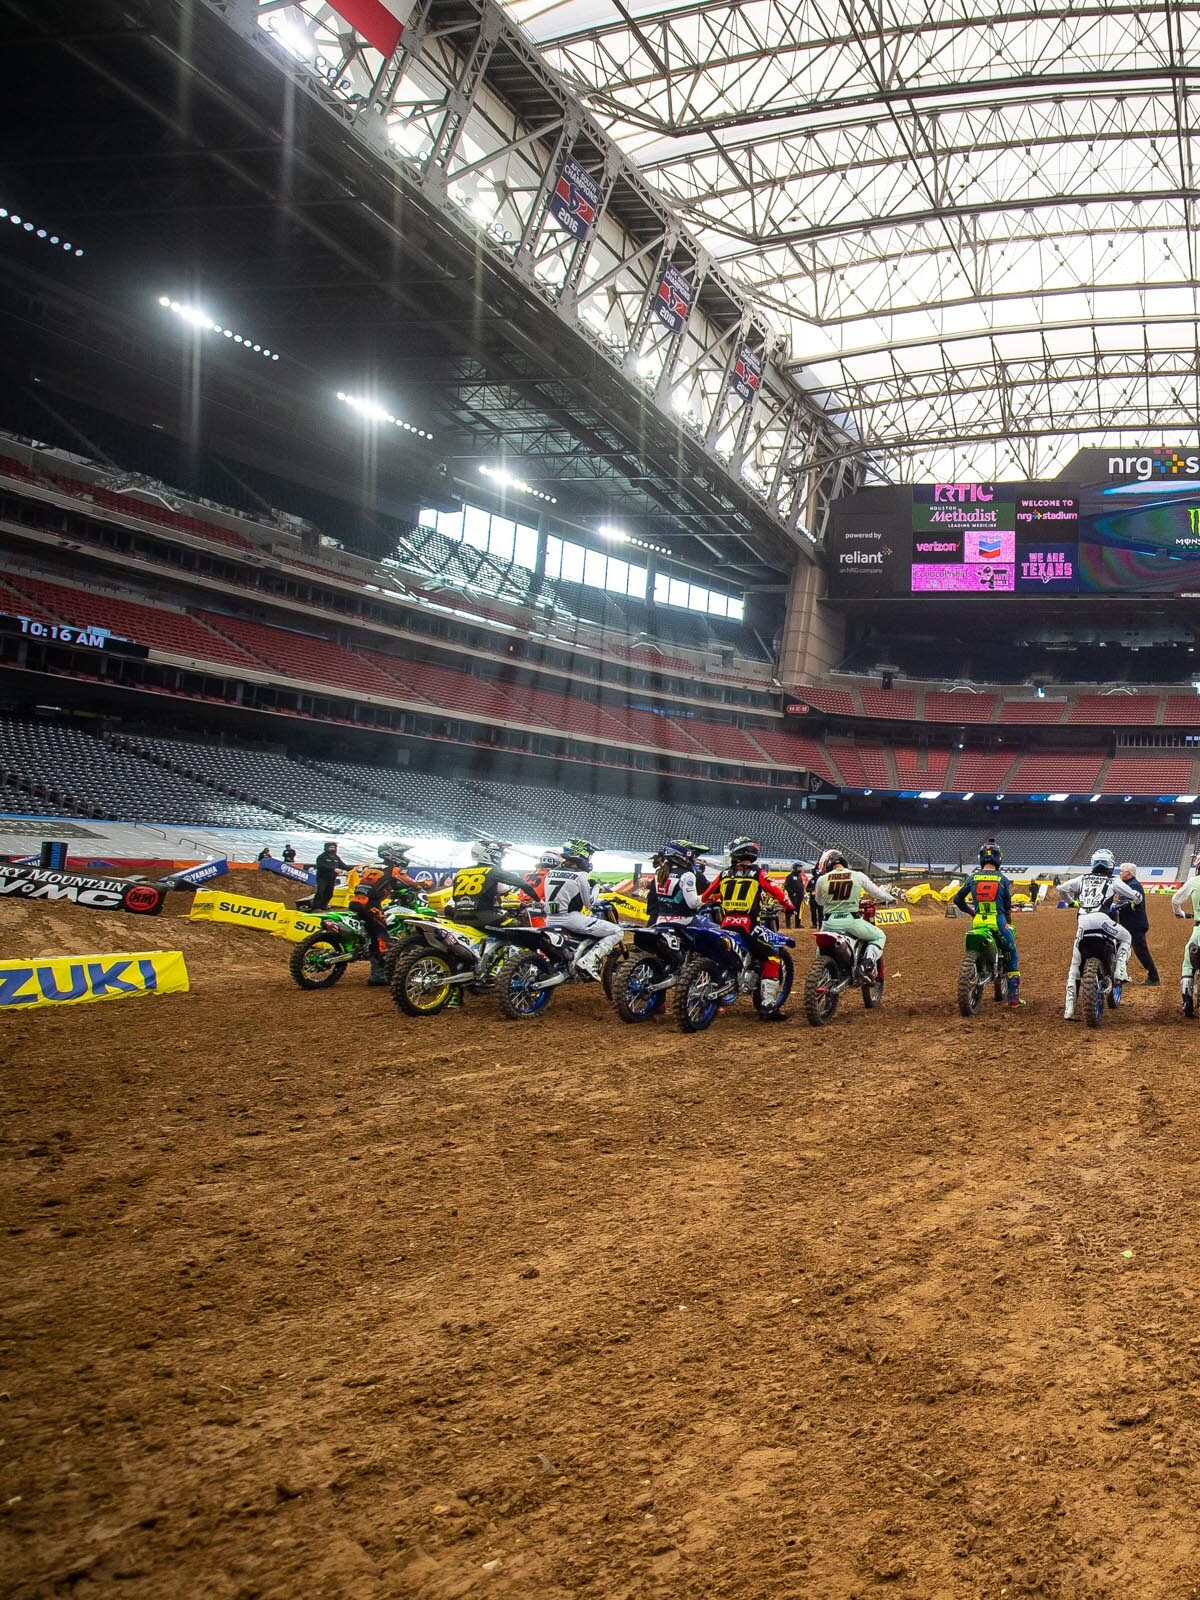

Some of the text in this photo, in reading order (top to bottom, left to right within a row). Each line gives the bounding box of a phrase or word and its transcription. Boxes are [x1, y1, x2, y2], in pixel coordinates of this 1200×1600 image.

[564, 164, 598, 204] CHAMPIONS
[558, 207, 579, 233] 2016
[660, 305, 676, 327] 2018
[1108, 456, 1152, 481] nrg
[930, 508, 997, 522] Methodist
[1017, 511, 1078, 522] nrg stadium
[845, 531, 882, 540] powered by
[840, 550, 884, 564] reliant
[916, 542, 956, 552] verizon
[1029, 553, 1065, 562] WE ARE
[1021, 563, 1072, 576] TEXANS
[20, 620, 105, 648] 10:16 AM
[26, 871, 127, 892] MOUNTAIN
[190, 865, 218, 882] YAMAHA
[286, 866, 309, 881] YAMAHA
[454, 874, 486, 896] 28
[549, 880, 566, 901] 7
[724, 880, 752, 900] 11
[828, 881, 853, 901] 40
[976, 881, 999, 902] 9
[219, 901, 278, 921] SUZUKI
[875, 911, 907, 924] SUZUKI
